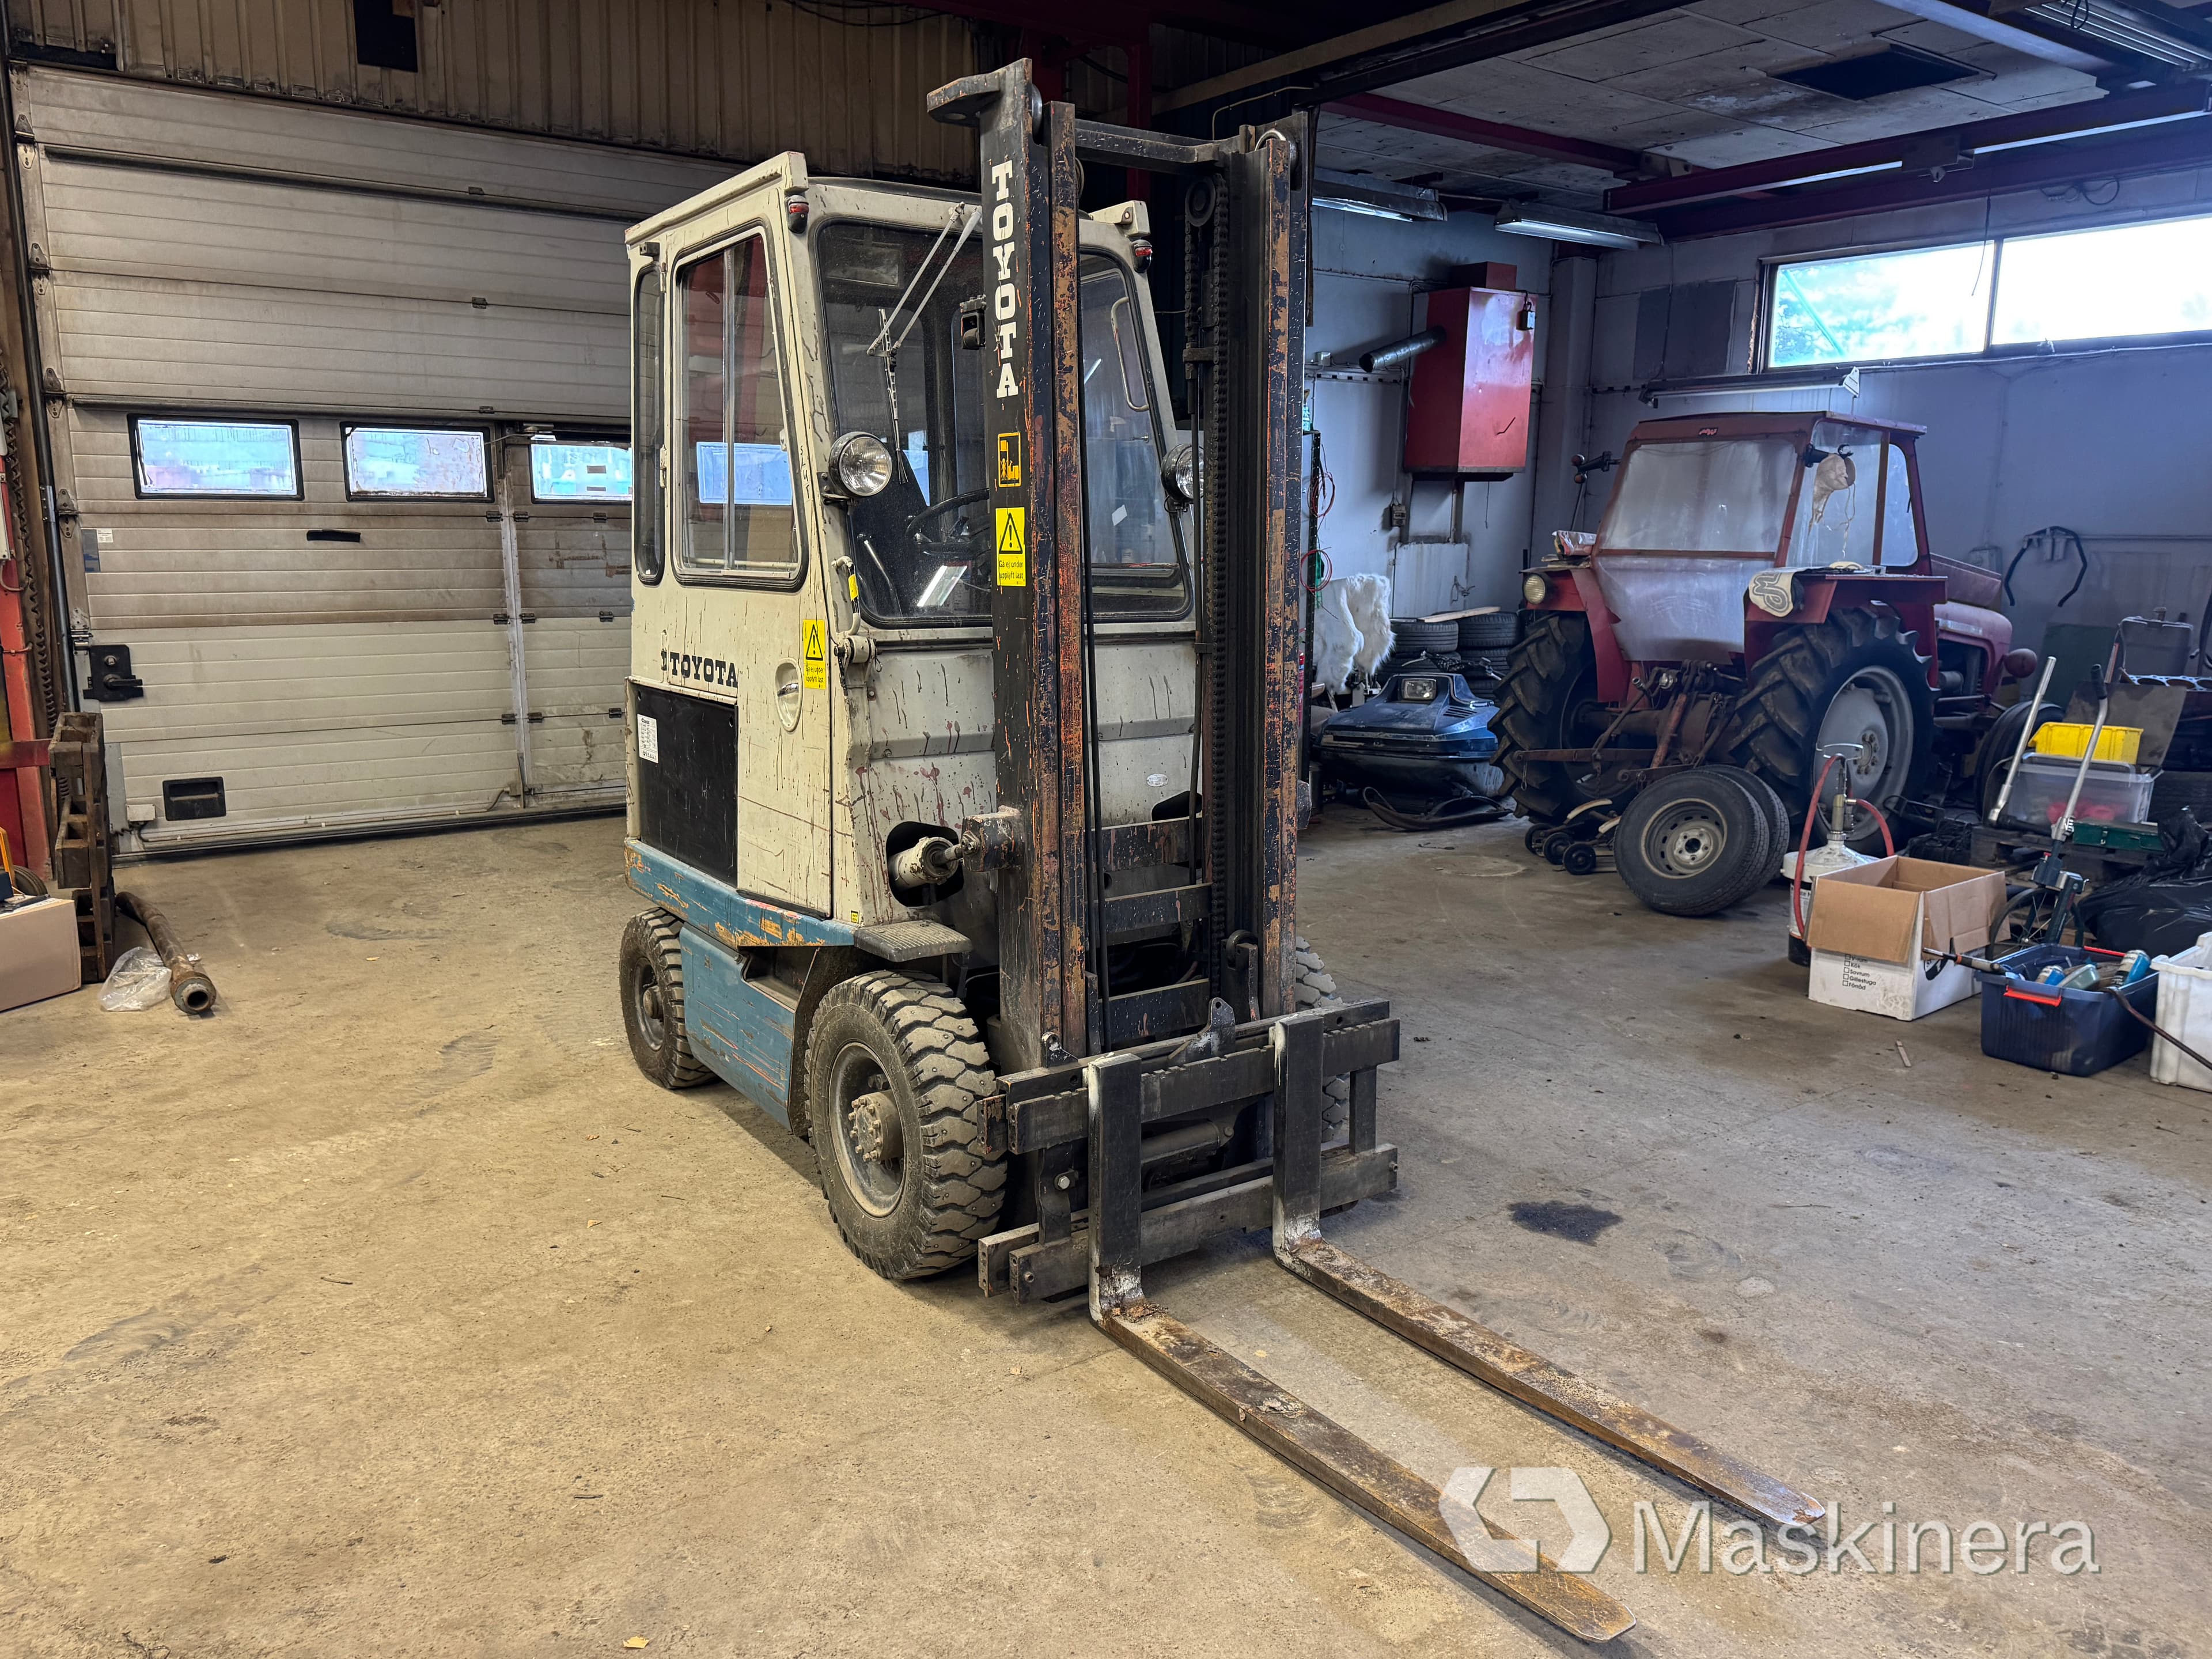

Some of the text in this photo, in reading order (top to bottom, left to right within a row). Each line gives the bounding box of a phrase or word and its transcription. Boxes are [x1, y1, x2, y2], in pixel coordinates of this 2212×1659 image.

[992, 160, 1018, 399] TOYOTA
[1006, 560, 1010, 569] ej
[999, 571, 1014, 580] upplyft
[670, 652, 738, 688] TOYOTA
[1849, 975, 1876, 985] Gillestuga
[1849, 982, 1866, 990] Förråd
